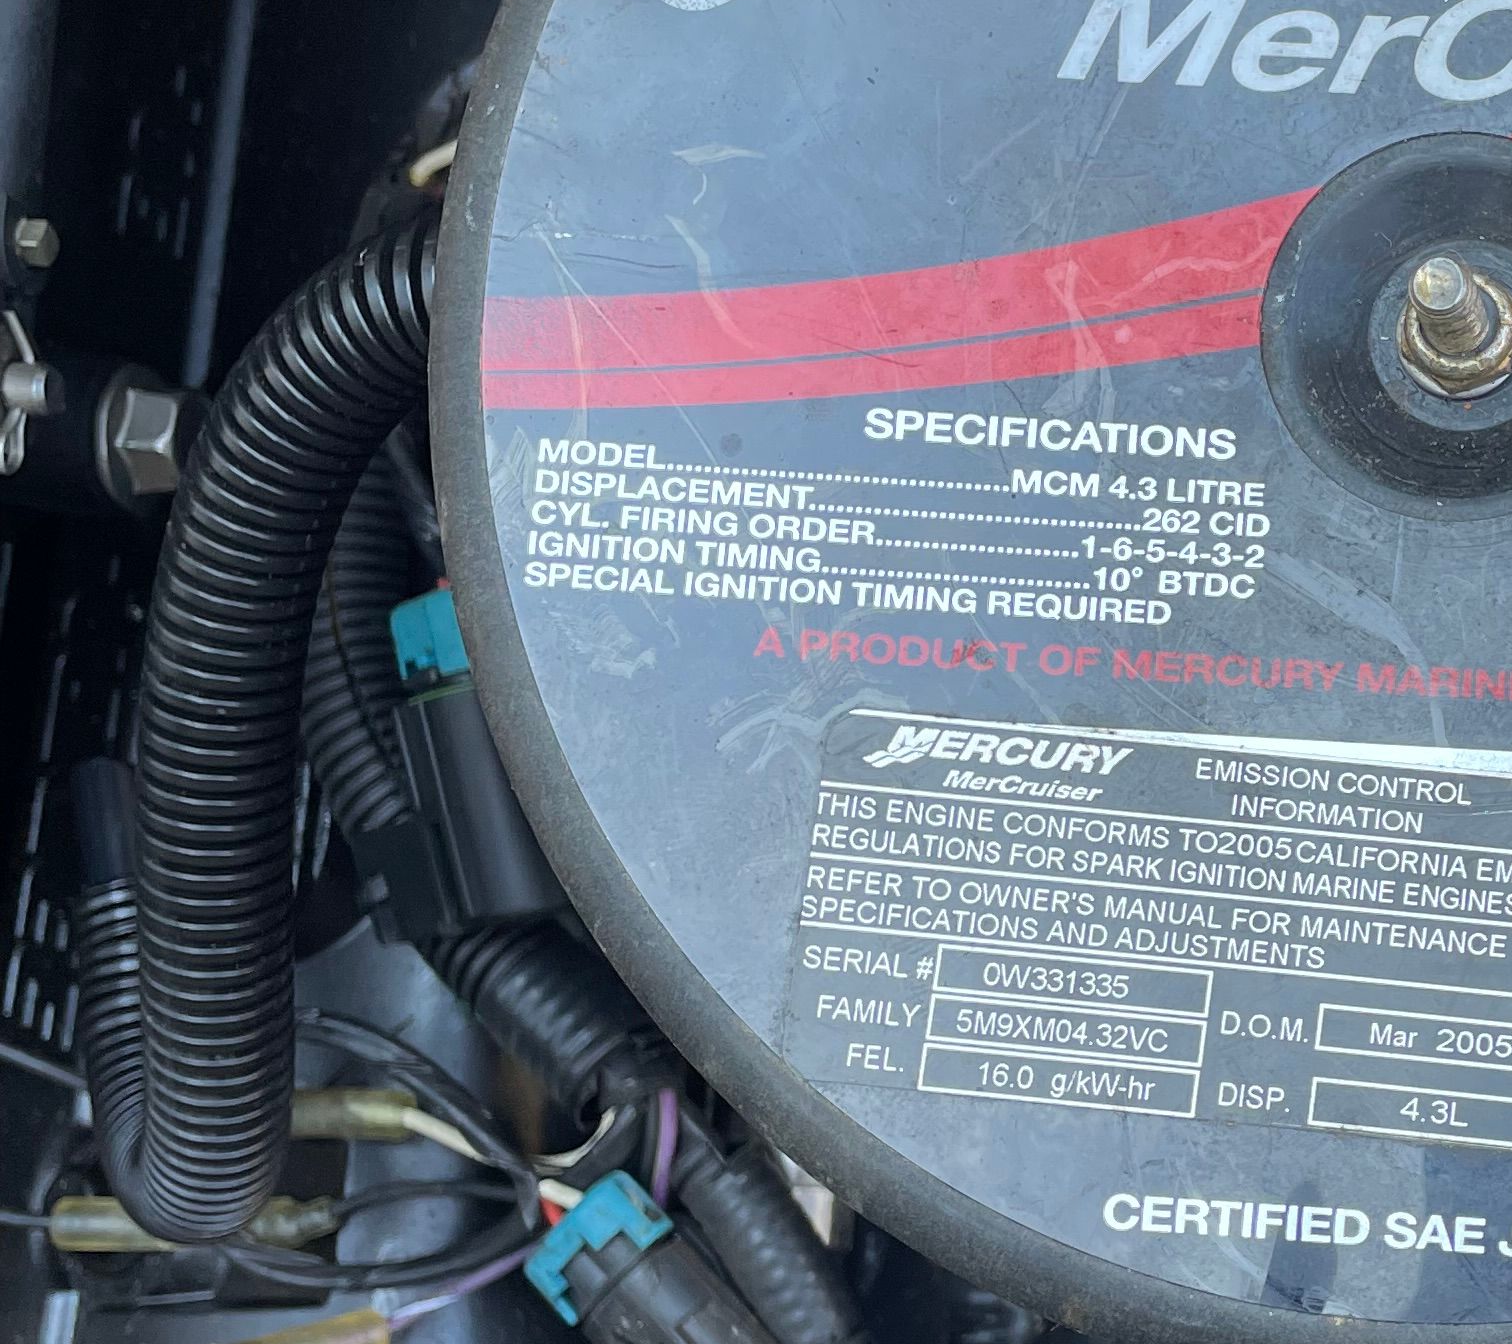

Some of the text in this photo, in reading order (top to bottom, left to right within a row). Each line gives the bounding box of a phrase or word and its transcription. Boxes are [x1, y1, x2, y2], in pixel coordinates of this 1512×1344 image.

[865, 408, 1236, 459] SPECIFICATIONS
[535, 467, 1270, 537] DISPLACEMENT 262 CID
[538, 438, 1265, 507] MODEL MCM 4.3 LITRE
[532, 500, 1264, 568] CYL. FIRING ORDER 1-6-5-4-3-2
[524, 561, 1171, 625] SPECIAL IGNITION TIMING REQUIRED
[529, 531, 685, 564] IGNITION
[696, 542, 820, 572] TIMING
[1159, 571, 1255, 599] BTDC
[754, 627, 784, 657] A
[799, 629, 1026, 672] PRODUCT
[1039, 644, 1101, 676] OF
[1113, 648, 1344, 690] MERCURY
[863, 726, 1133, 775] MERCURY
[943, 770, 1103, 801] MerCruiser
[1196, 758, 1471, 805] EMISSION CONTROL
[818, 792, 876, 819] THIS
[886, 799, 994, 831] ENGINE
[1003, 812, 1169, 848] CONFORMS
[1297, 841, 1467, 878] CALIFORNIA
[1232, 795, 1423, 833] INFORMATION
[812, 824, 1001, 863] REGULATIONS
[1009, 843, 1065, 870] FOR
[1072, 850, 1163, 880] SPARK
[1170, 859, 1286, 892] IGNITION
[1293, 872, 1395, 903] MARINE
[802, 896, 1325, 969] SPECIFICATIONS AND ADJUSTMENTS
[807, 865, 1507, 957] REFER TO OWNER'S MANUAL FOR MAINTENANCE
[803, 945, 1129, 998] SERIAL # 0W331335
[817, 995, 1167, 1052] FAMILY 5M9XM04.32VC
[1221, 1011, 1512, 1057] D.O.M. Mar 2005
[847, 1043, 1155, 1100] FEL. 16.0 g/kW-hr
[1218, 1082, 1468, 1126] DISP. 4.3L
[1103, 1194, 1370, 1245] CERTIFIED
[1384, 1212, 1486, 1253] SAE
